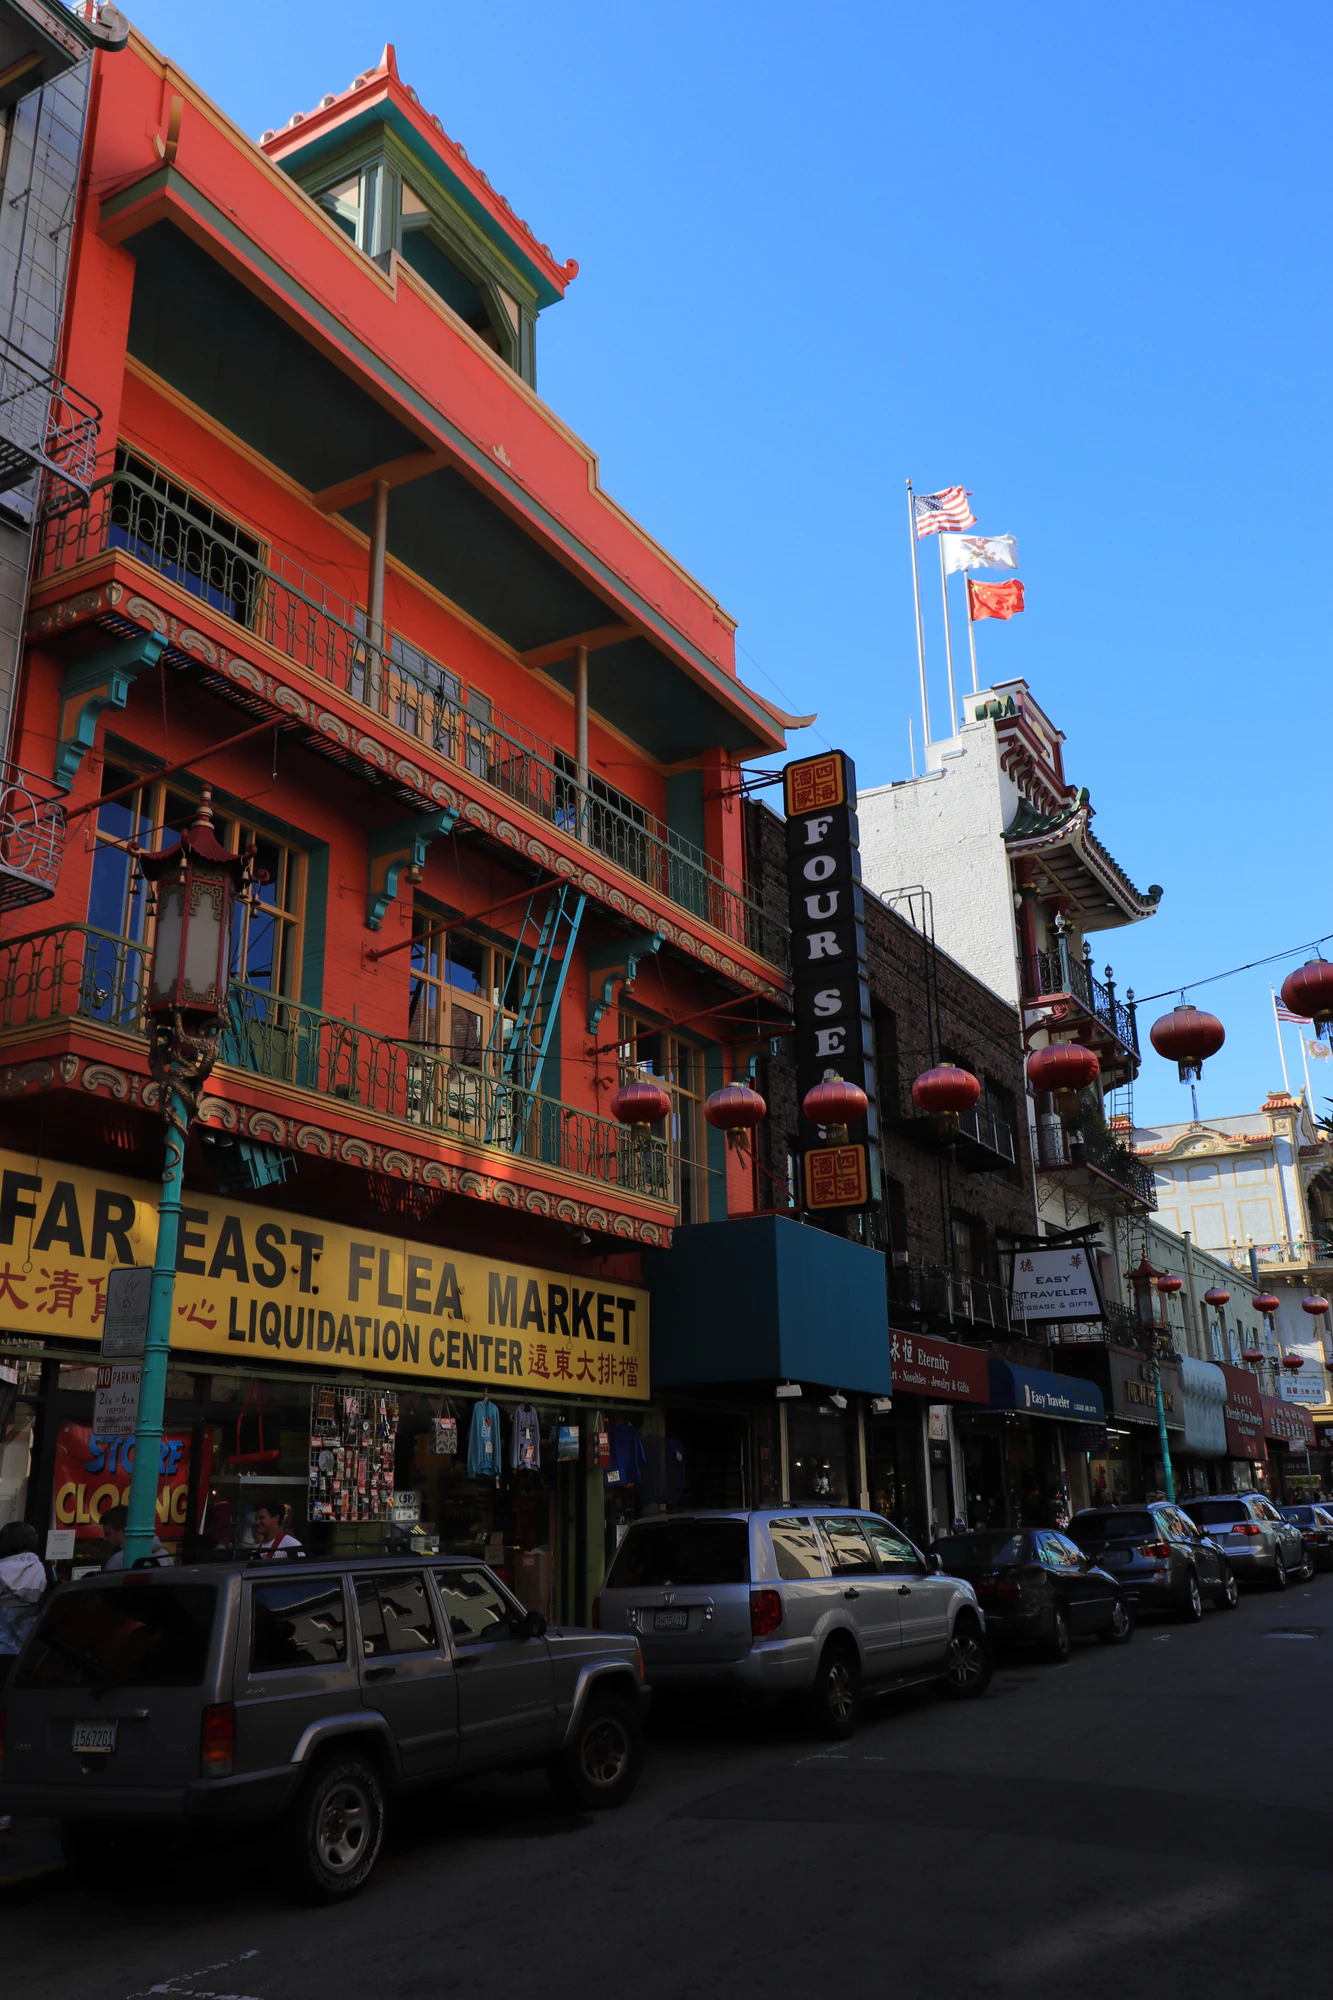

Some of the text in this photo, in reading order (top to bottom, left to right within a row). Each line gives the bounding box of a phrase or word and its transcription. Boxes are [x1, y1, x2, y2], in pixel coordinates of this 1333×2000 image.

[804, 815, 842, 960] FOUR
[814, 989, 846, 1139] SE
[0, 1170, 636, 1345] FAR EAST FLEA MARKET
[1036, 1275, 1070, 1284] EASY
[1022, 1288, 1087, 1299] TRAVELER
[229, 1297, 522, 1376] LIQUIDATION CENTER
[527, 1343, 638, 1387] 遠東大排檔
[917, 1348, 949, 1374] Eternity
[98, 1368, 140, 1386] NO PARKING
[902, 1370, 926, 1385] Novelties
[931, 1376, 950, 1391] Jewelry
[952, 1380, 956, 1390] &
[957, 1381, 969, 1393] Gifts
[1031, 1391, 1046, 1408] Easy
[1046, 1393, 1070, 1408] Traveler
[1125, 1380, 1146, 1405] NEW
